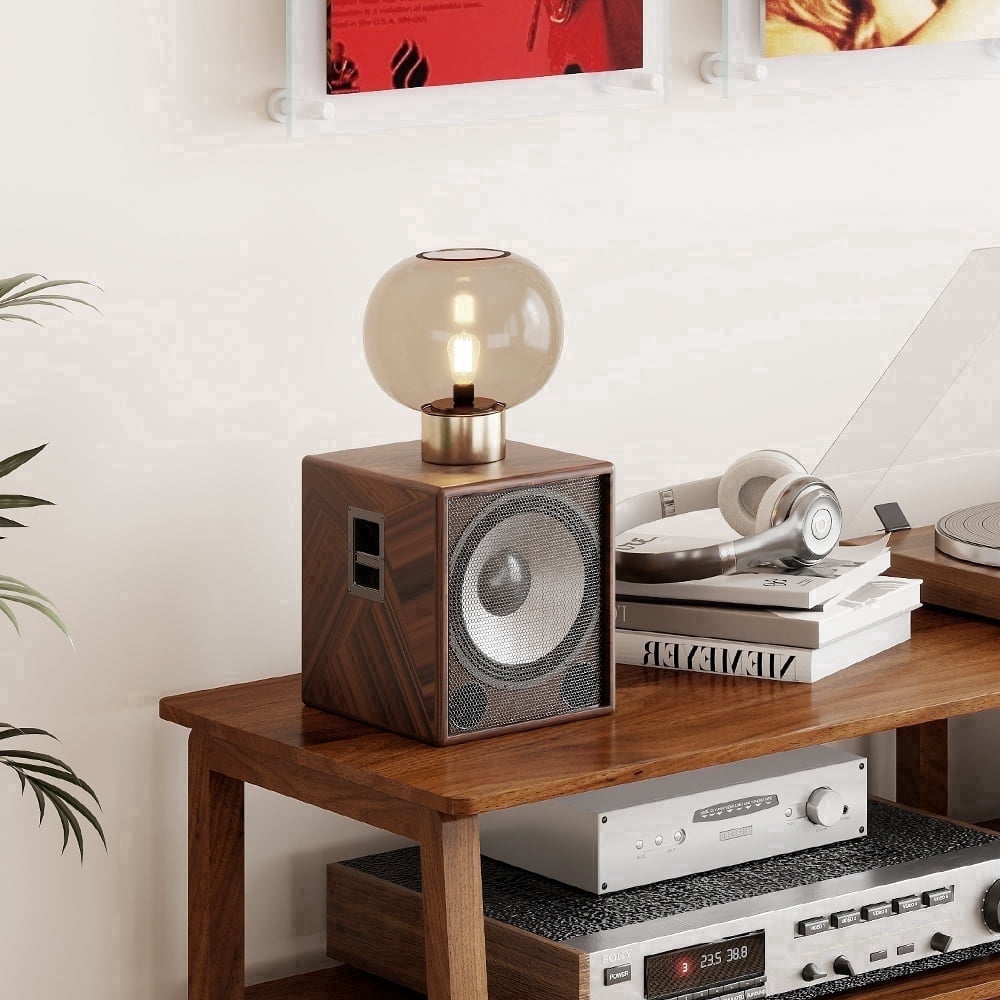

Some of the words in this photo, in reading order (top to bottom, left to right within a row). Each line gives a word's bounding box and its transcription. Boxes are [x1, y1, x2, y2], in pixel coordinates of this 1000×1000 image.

[602, 950, 632, 965] SONY
[682, 963, 688, 973] 3
[700, 951, 722, 969] 23.5
[726, 945, 748, 962] 38.8
[609, 970, 629, 980] POWER
